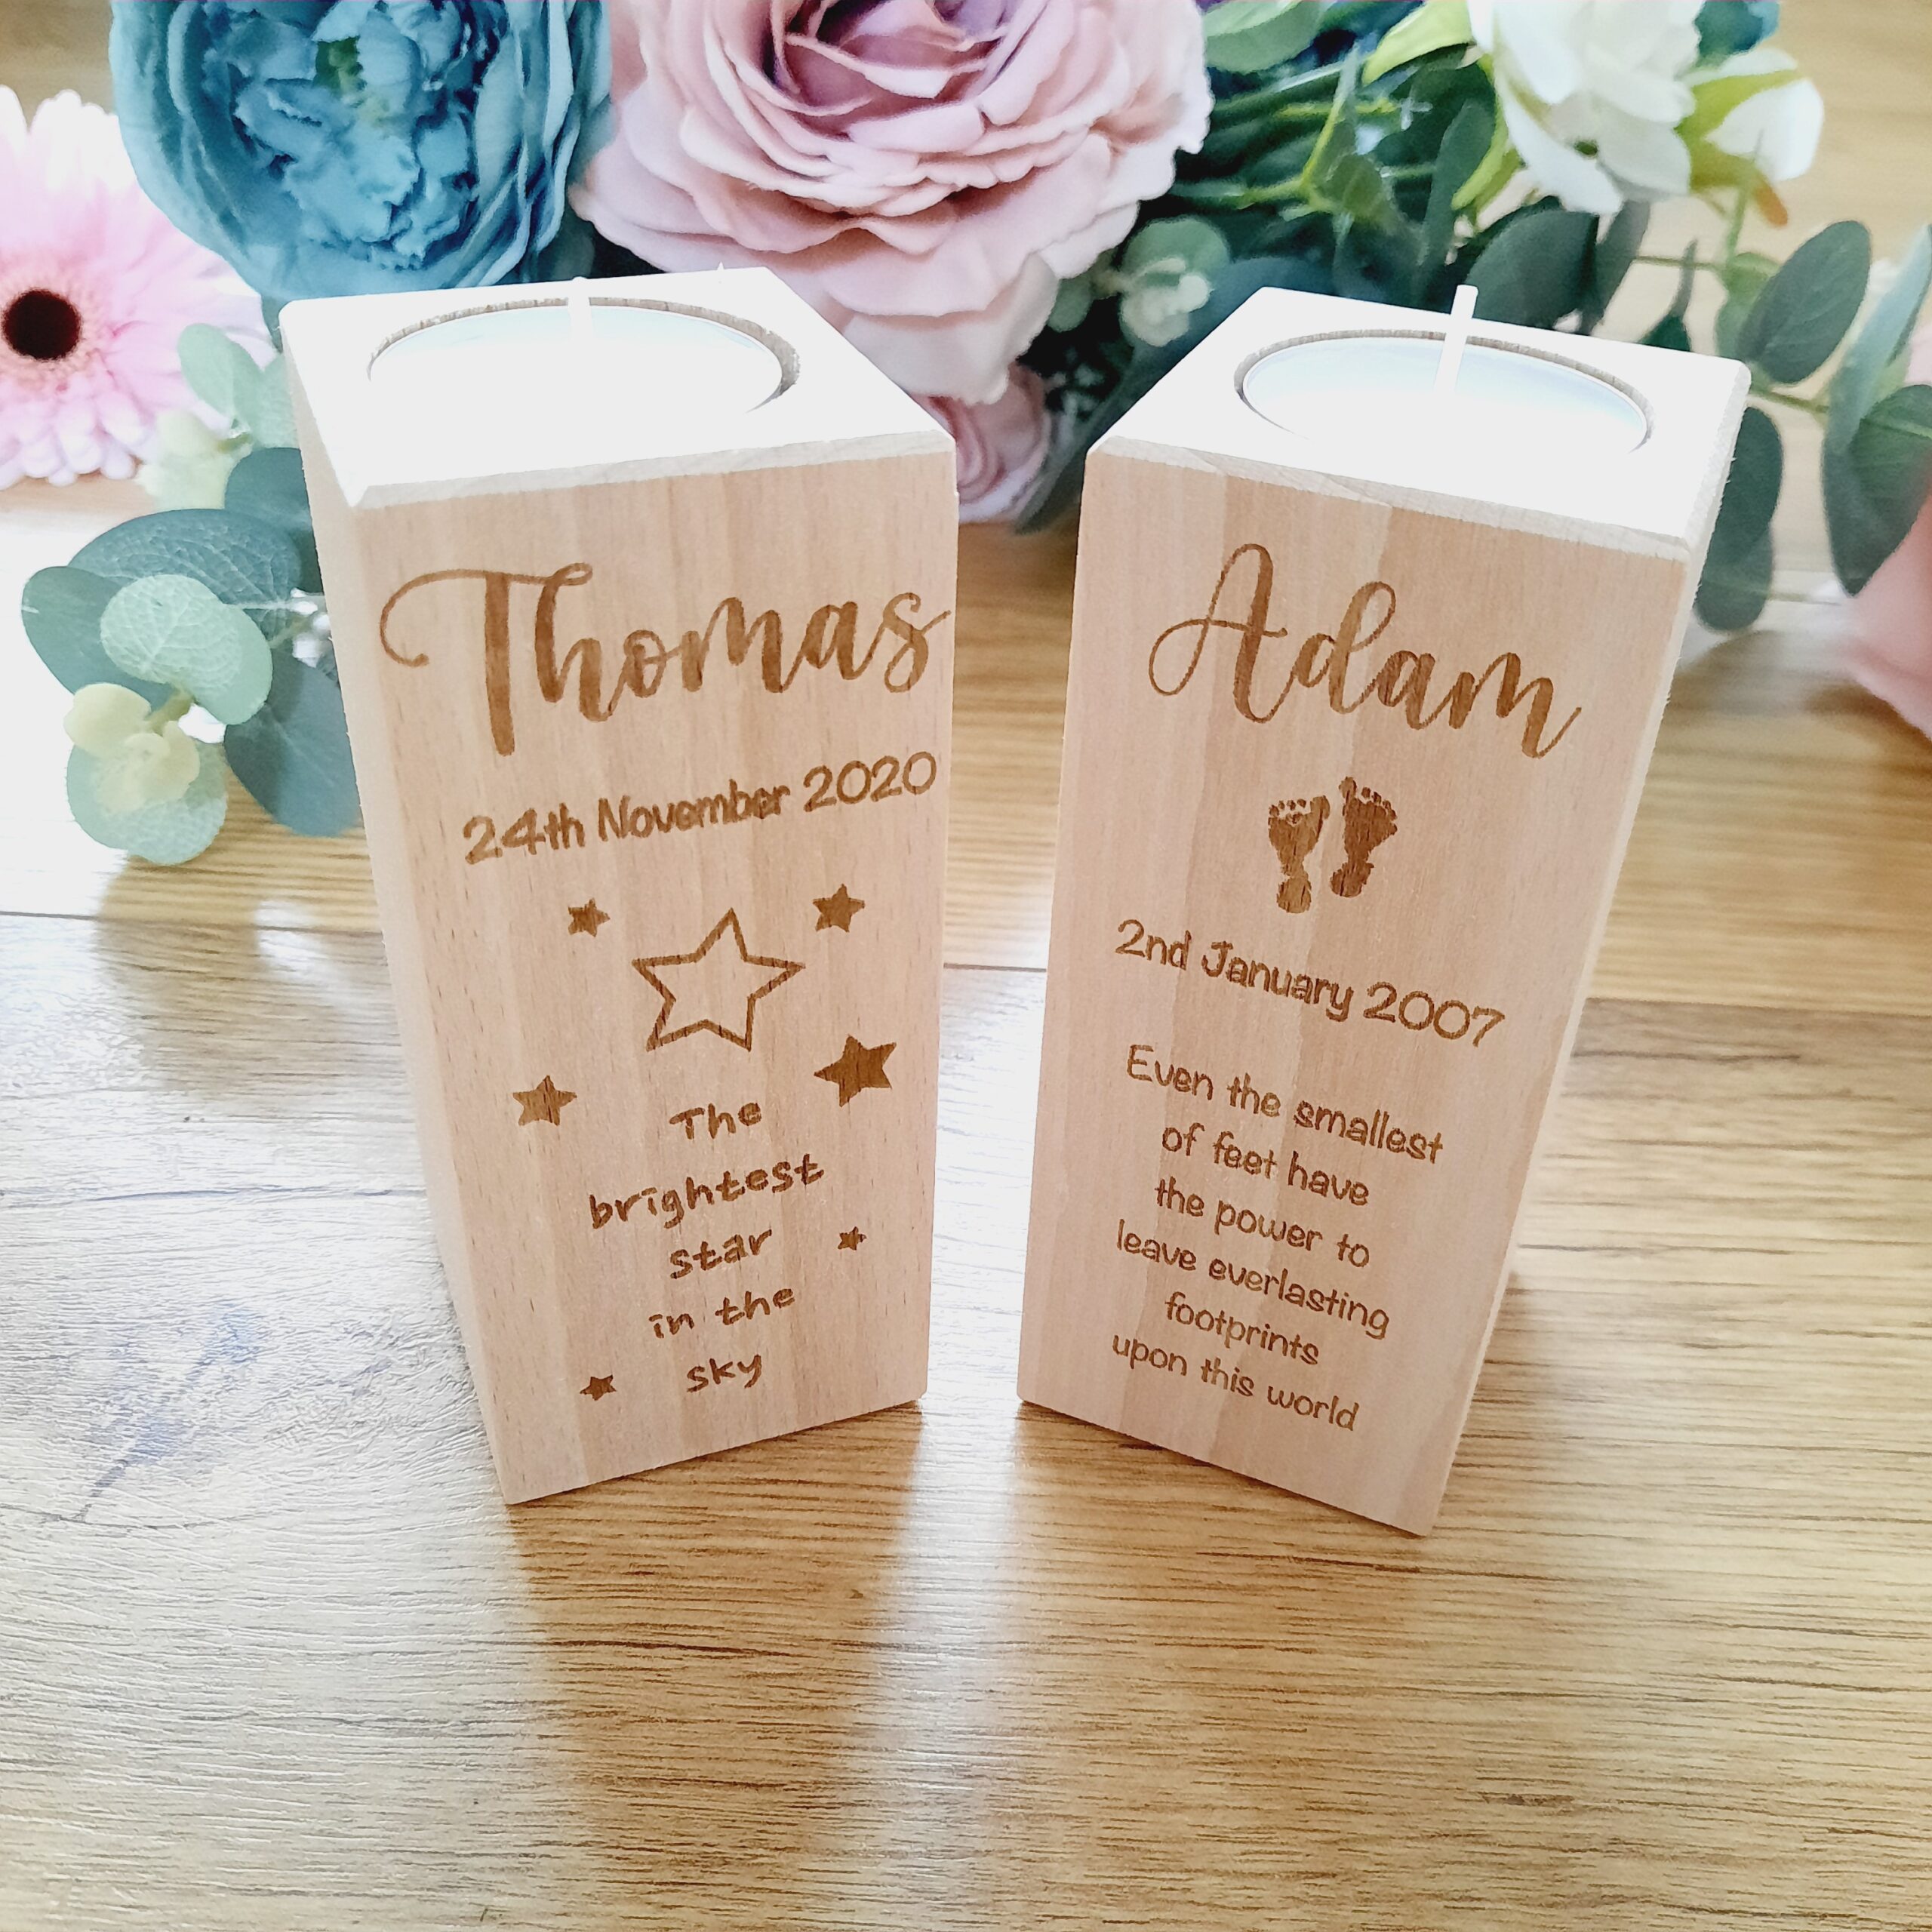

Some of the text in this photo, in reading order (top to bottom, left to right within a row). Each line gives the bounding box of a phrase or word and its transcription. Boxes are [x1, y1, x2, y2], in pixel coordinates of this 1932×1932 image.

[380, 563, 951, 756] Thomas
[1149, 543, 1582, 758] Adam
[463, 751, 937, 865] 24th November 2020
[1115, 918, 1505, 1048] 2nd January 2007
[669, 1103, 762, 1139] The
[1127, 1044, 1443, 1164] Even the smallest
[589, 1154, 824, 1229] brightest
[1161, 1122, 1370, 1205] of feet have
[670, 1229, 772, 1278] star
[1154, 1177, 1370, 1268] the power to
[648, 1287, 795, 1339] in the
[1116, 1219, 1390, 1340] leave everlasting
[687, 1354, 761, 1392] sky
[1164, 1291, 1319, 1365] footprints
[1112, 1334, 1360, 1432] upon this world
